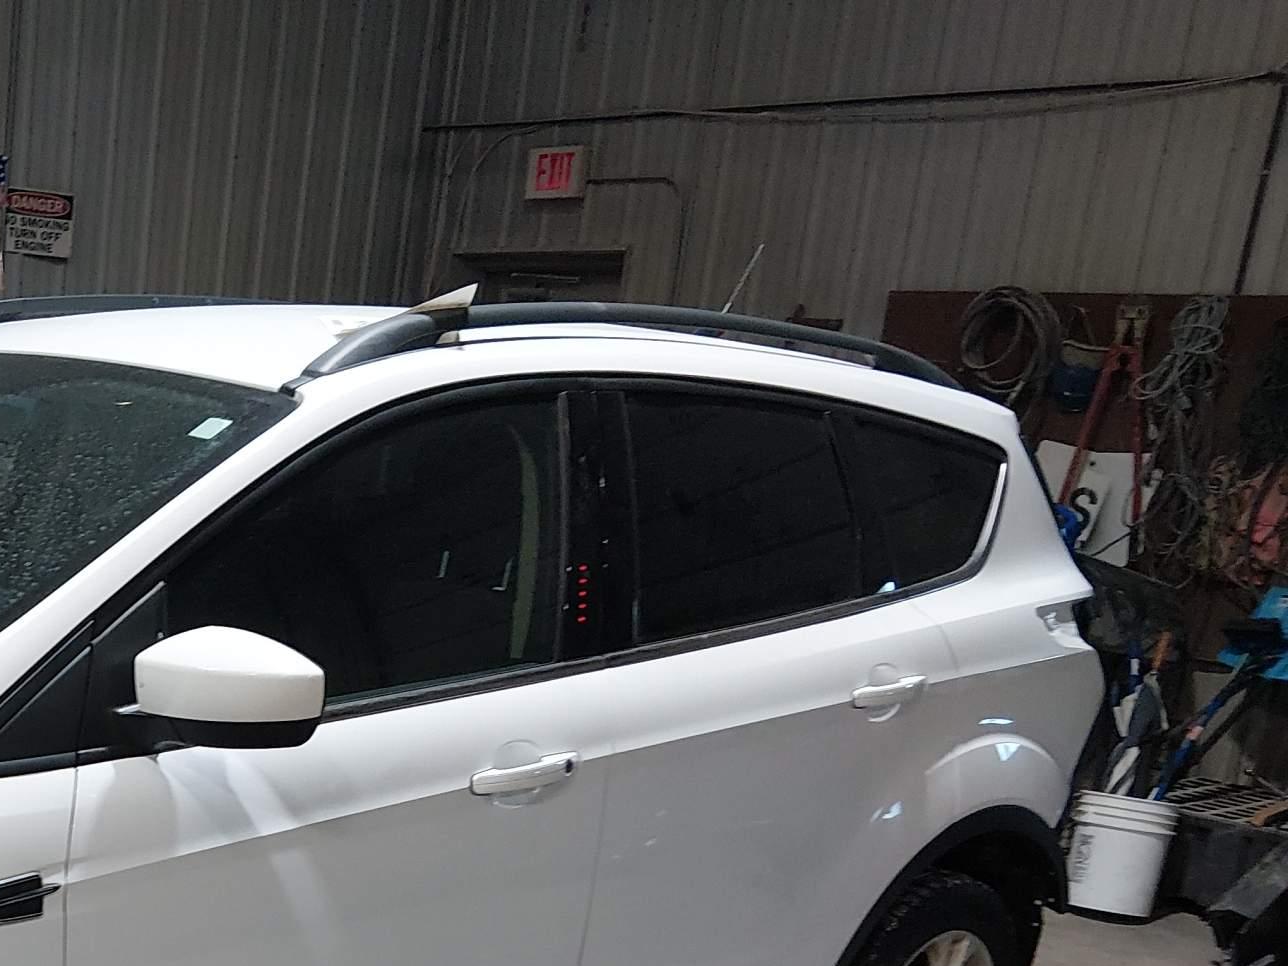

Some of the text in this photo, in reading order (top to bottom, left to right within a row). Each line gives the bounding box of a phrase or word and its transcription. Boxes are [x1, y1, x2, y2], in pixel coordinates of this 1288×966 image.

[536, 152, 575, 191] EXIT
[12, 195, 65, 213] DANGER
[20, 216, 70, 232] SMOKING
[10, 227, 63, 242] TURN OFF
[14, 239, 54, 254] ENGINE
